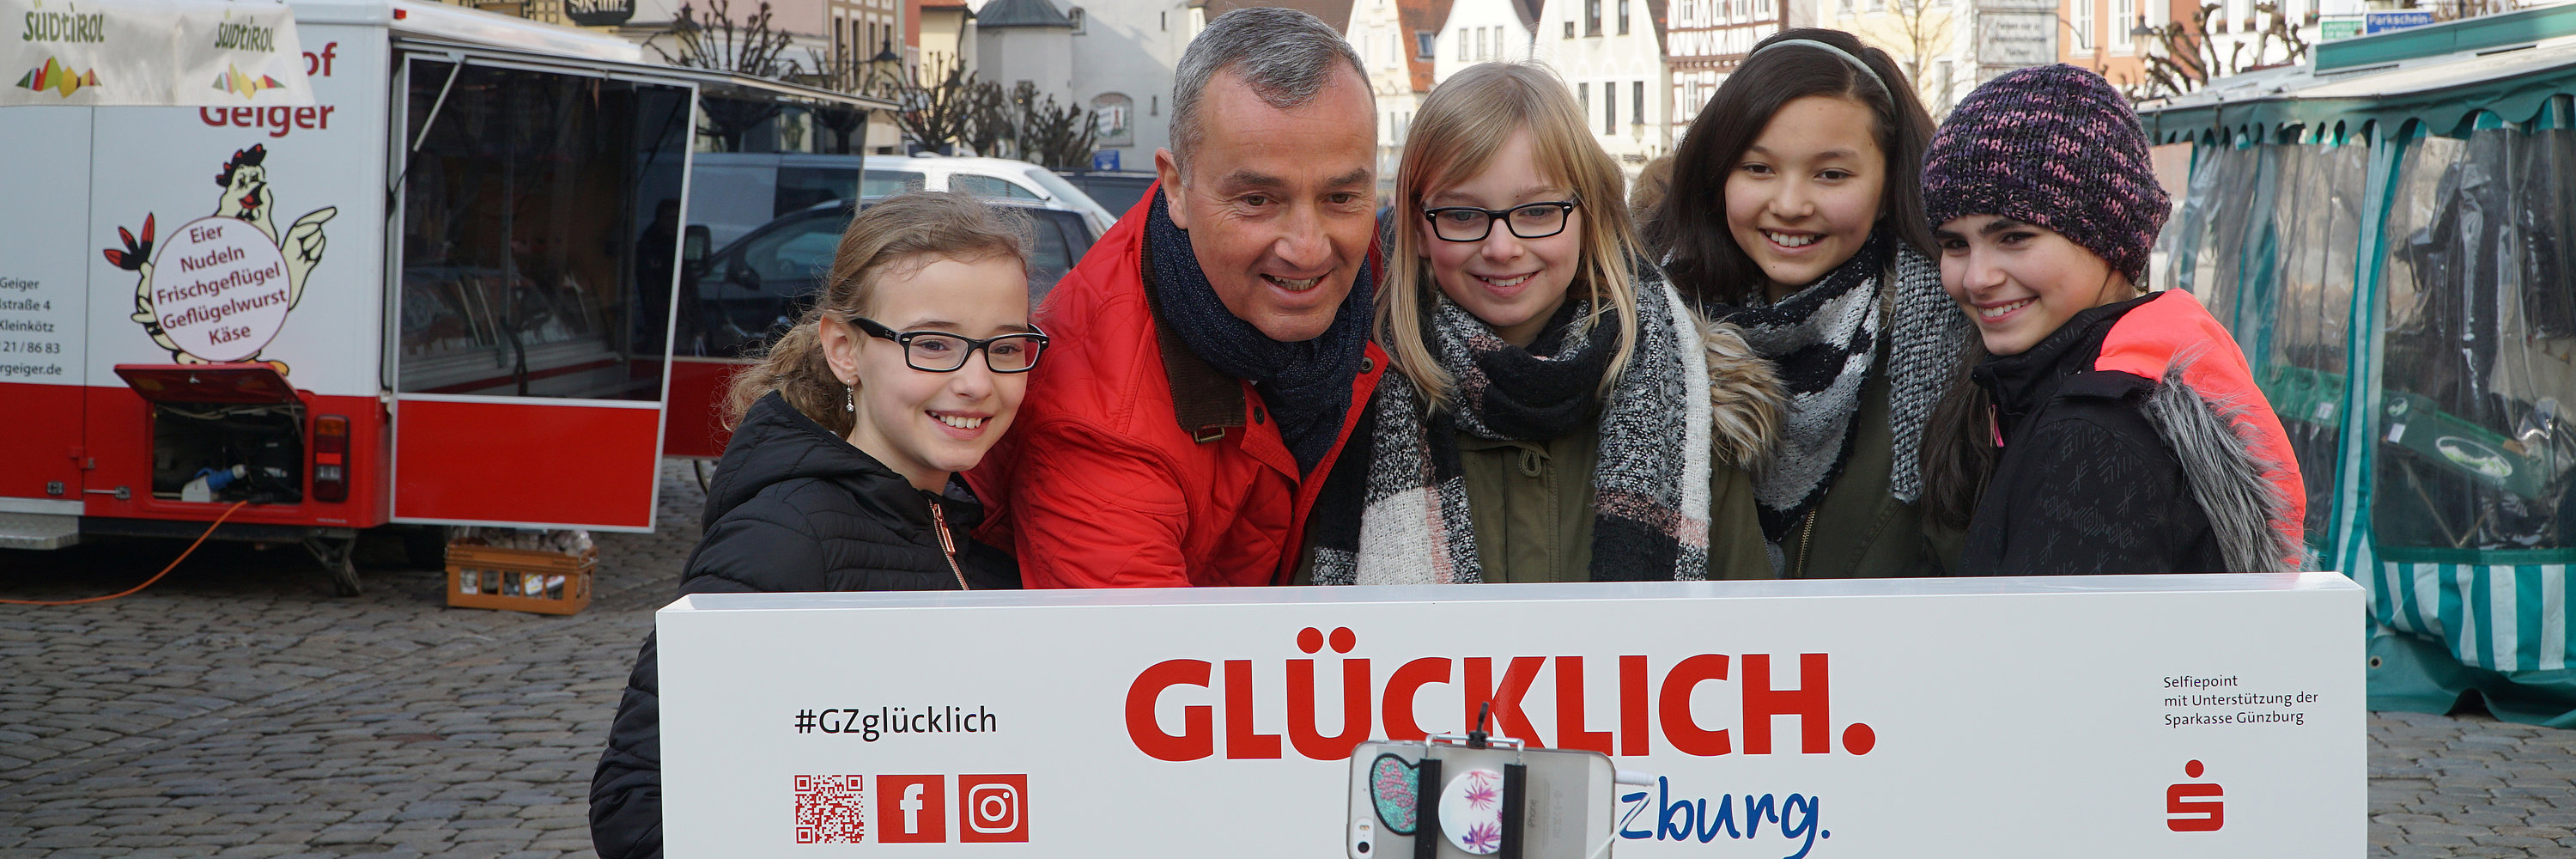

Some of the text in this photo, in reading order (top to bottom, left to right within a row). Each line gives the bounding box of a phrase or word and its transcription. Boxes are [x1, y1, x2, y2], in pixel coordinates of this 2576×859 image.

[190, 226, 223, 244] Eier
[180, 246, 246, 273] Nudeln
[0, 277, 39, 292] Geiger
[156, 261, 281, 305] Frischgeflügel
[43, 301, 51, 311] 4
[162, 289, 287, 329] Geflügelwurst
[209, 326, 251, 345] Käse
[45, 343, 60, 354] 83
[2164, 674, 2238, 691] Selfiepoint
[1125, 627, 1876, 762] GLÜCKLICH.
[2165, 691, 2318, 707] mit Unterstützung der
[794, 705, 997, 742] #GZglücklich
[2165, 710, 2304, 728] Sparkasse Günzburg
